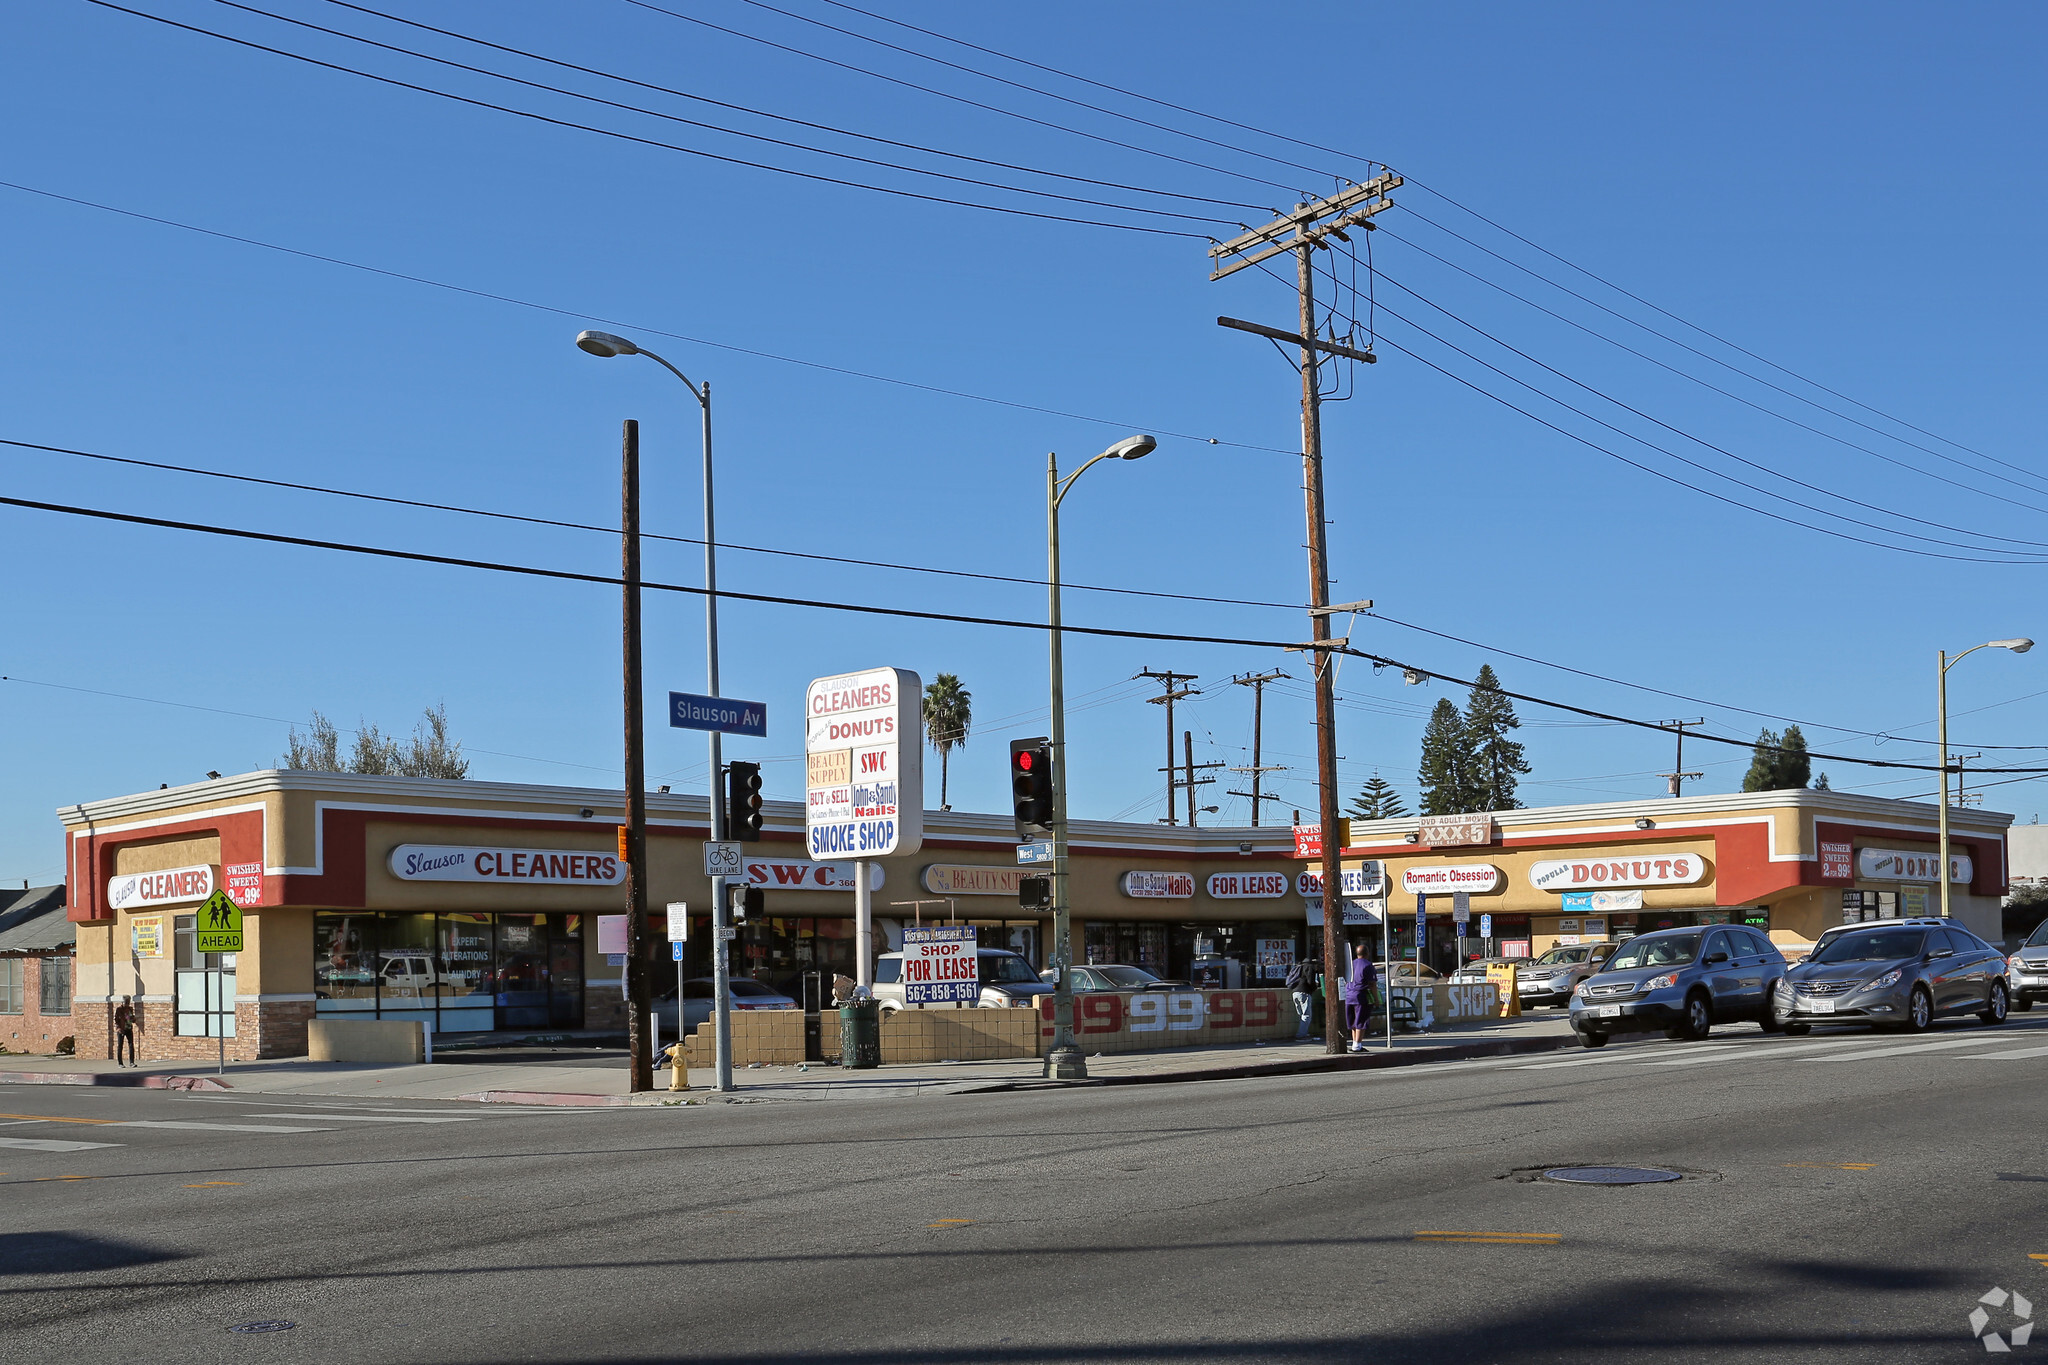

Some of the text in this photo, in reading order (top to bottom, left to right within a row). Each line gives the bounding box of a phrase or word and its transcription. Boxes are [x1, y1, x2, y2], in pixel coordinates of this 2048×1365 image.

[820, 678, 859, 693] SLAUSON
[813, 683, 891, 714] CLEANERS
[677, 701, 761, 727] Slauson Av
[830, 717, 894, 740] DONUTS
[810, 751, 887, 773] BEAUTY SWC
[810, 768, 847, 784] SUPPLY
[810, 792, 825, 806] BUY
[832, 789, 849, 804] SELL
[855, 805, 896, 817] Nails
[1440, 816, 1462, 824] ADULT
[1465, 814, 1489, 822] MOVIE
[812, 820, 894, 854] SMOKE SHOP
[1295, 826, 1322, 835] SWIS
[1423, 826, 1464, 841] XXX
[1019, 849, 1033, 859] West
[1299, 844, 1309, 855] 2
[1822, 843, 1851, 853] SWISHER
[405, 852, 617, 880] Slauson CLEANERS
[1824, 855, 1849, 863] SWEETS
[226, 864, 262, 876] SWISHER
[1536, 859, 1690, 886] POPULAR DONUTS
[1823, 864, 1830, 877] 2
[1894, 856, 1958, 879] DONUS
[229, 876, 259, 888] SWEETS
[953, 869, 998, 891] BEAUTY
[1406, 868, 1495, 884] Romantic Obsession
[139, 870, 208, 901] CLEANERS
[1168, 875, 1192, 895] Nails
[1212, 876, 1283, 895] FOR LEASE
[1566, 897, 1587, 906] PLAY
[1843, 893, 1860, 901] ATM
[200, 936, 240, 947] AHEAD
[452, 937, 479, 947] EXPERT
[1264, 941, 1288, 950] FOR
[441, 951, 489, 961] ALTERATIONS
[921, 944, 960, 956] SHOP
[1258, 951, 1293, 966] LEASE
[906, 957, 976, 981] FOR LEASE
[907, 983, 977, 1001] 562-858-1561
[1448, 985, 1496, 1017] SHOP
